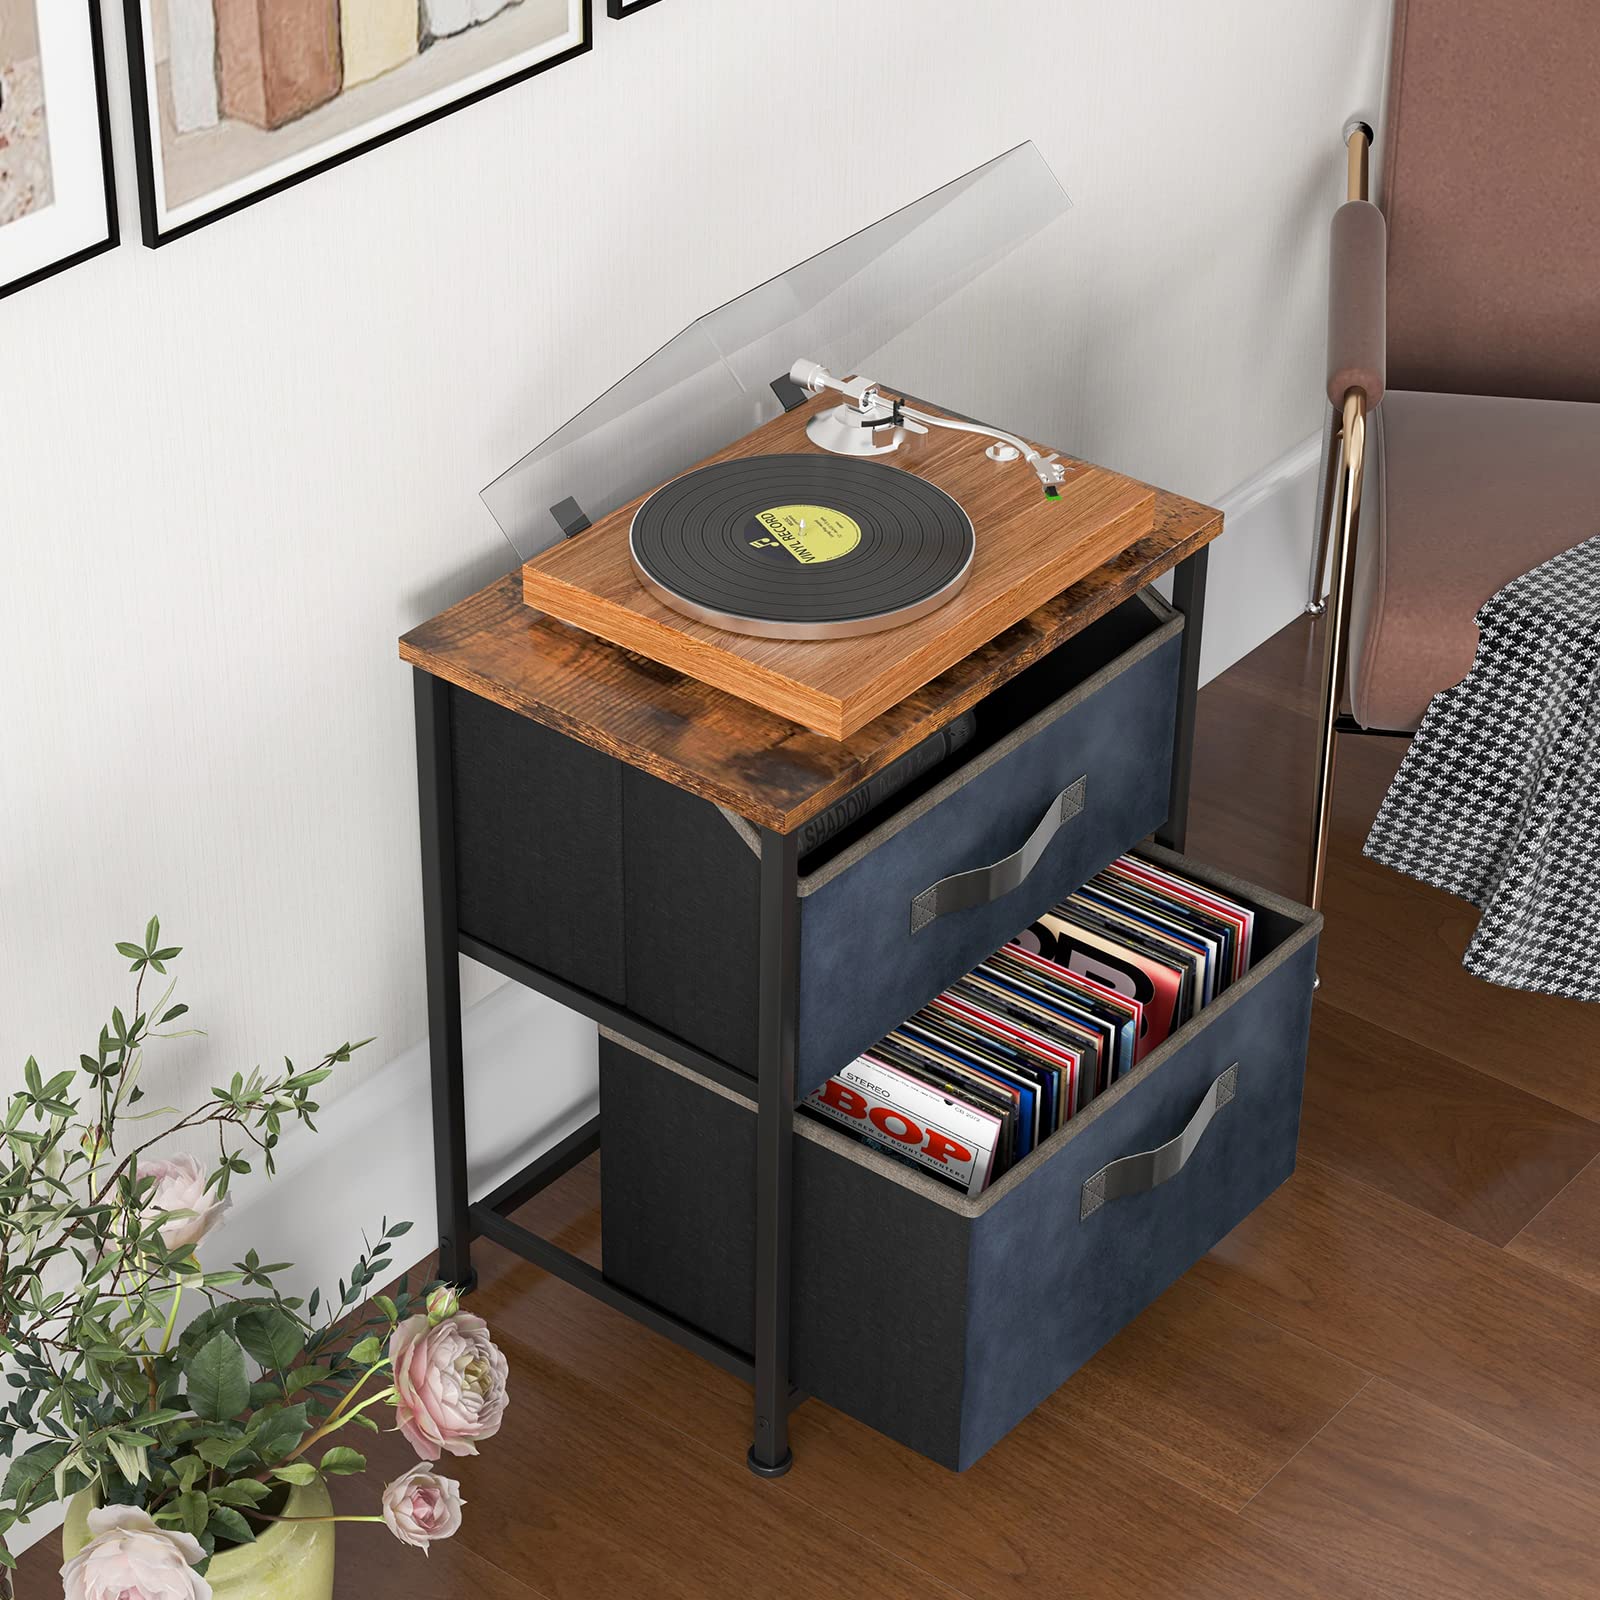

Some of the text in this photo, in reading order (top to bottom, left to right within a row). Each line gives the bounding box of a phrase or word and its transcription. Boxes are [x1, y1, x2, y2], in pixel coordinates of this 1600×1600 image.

[760, 512, 796, 542] RECORD
[789, 541, 816, 563] VINYL
[804, 785, 872, 852] SHADOW
[846, 1072, 891, 1099] STEREO
[810, 1080, 972, 1164] BOP
[852, 1120, 875, 1134] CREW
[877, 1132, 888, 1140] OF
[890, 1139, 923, 1158] BOUNTY
[927, 1157, 966, 1180] HUNTERS
